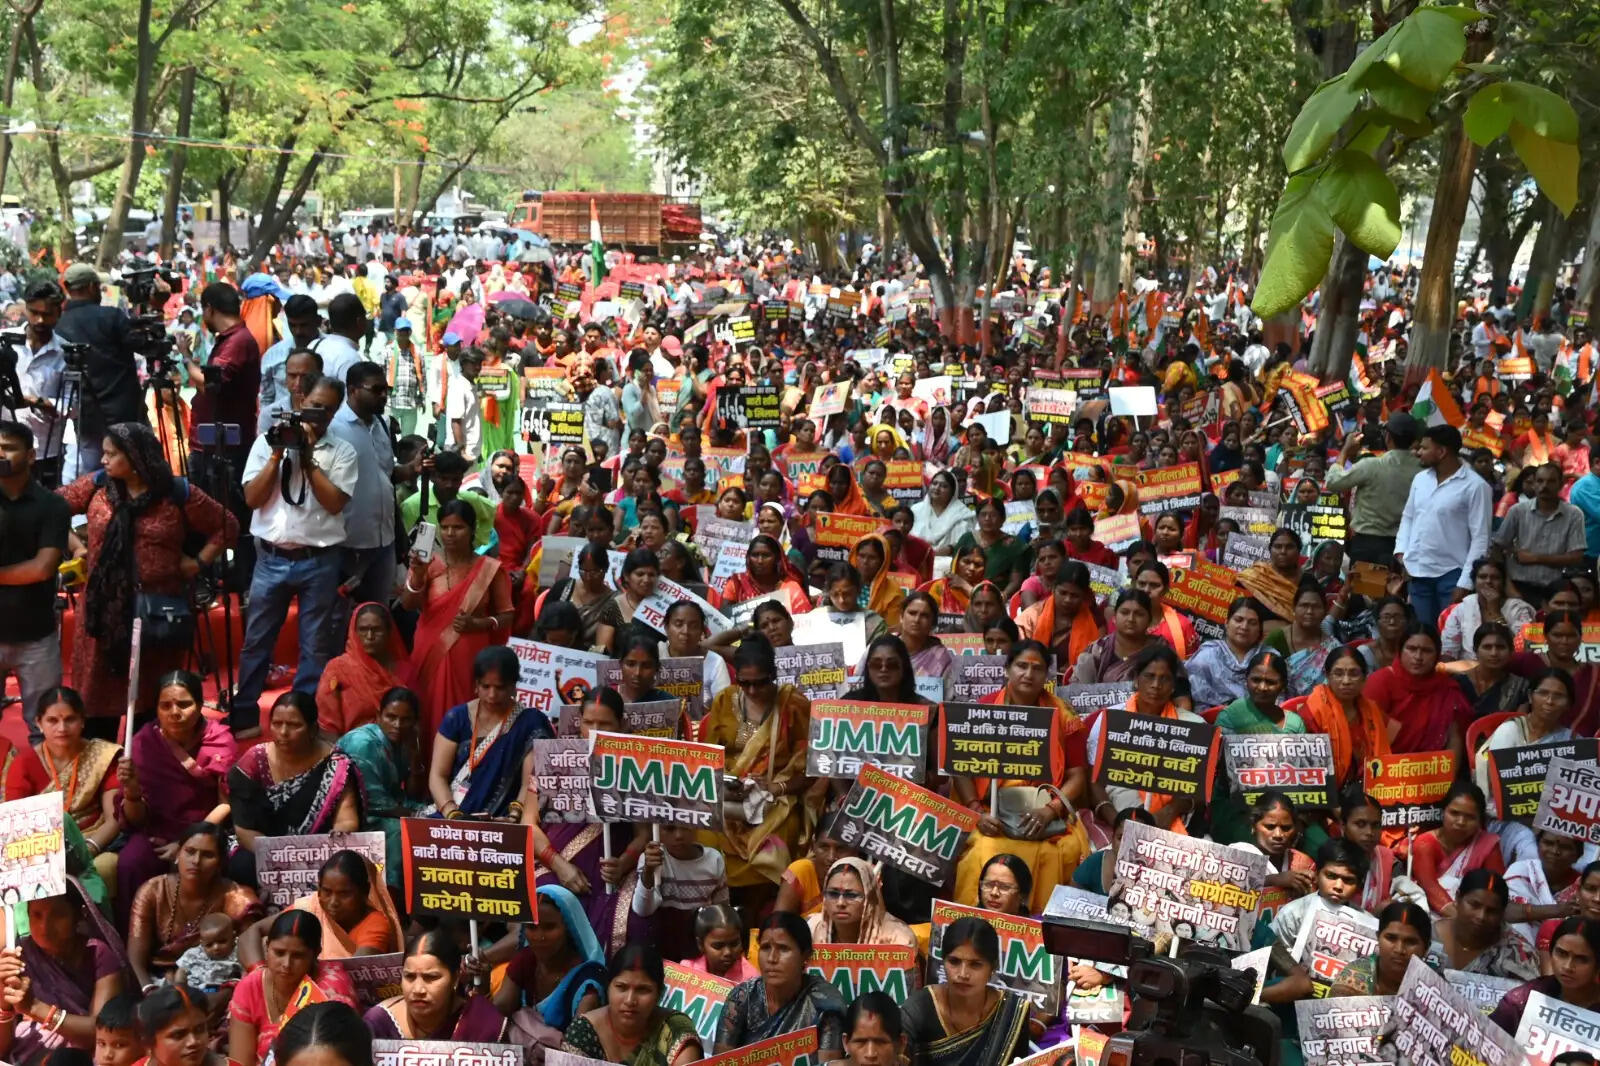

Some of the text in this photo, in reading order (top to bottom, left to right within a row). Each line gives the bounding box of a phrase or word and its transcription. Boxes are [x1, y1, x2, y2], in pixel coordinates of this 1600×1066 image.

[968, 708, 1028, 722] JMM का हाथ
[812, 717, 922, 757] JMM
[948, 722, 1048, 738] नारी शक्ति के खिलाफ
[1130, 718, 1190, 738] JMM का हाथ
[952, 739, 1043, 756] जनता नहीं
[1108, 731, 1208, 756] नारी शक्ति के खिलाफ
[1229, 737, 1327, 758] महिला विरोधी
[1517, 745, 1576, 763] JMM का हाथ
[816, 754, 834, 774] है
[952, 757, 1044, 776] करेगी माफ
[1110, 747, 1202, 774] जनता नहीं
[1387, 755, 1452, 778] महिलाओं के
[1500, 763, 1548, 779] नारी शक्ति
[538, 774, 558, 790] पर
[594, 753, 718, 804] JMM
[1107, 768, 1198, 794] करेगी माफ
[1234, 762, 1328, 787] कांग्रेस
[865, 770, 973, 825] महिलाओं के अधिकारों पर वार
[1405, 784, 1418, 798] का
[552, 794, 586, 811] की है
[601, 793, 713, 827] है जिम्मेदार
[845, 786, 962, 861] JMM
[1398, 807, 1406, 825] है
[1544, 816, 1587, 837] JMM
[429, 825, 504, 844] कांग्रेस का हाथ
[271, 844, 331, 864] महिलाओं
[412, 844, 524, 866] नारी शक्ति के खिलाफ
[840, 821, 940, 879] है जिम्मेदार
[1137, 838, 1250, 882] महिलाओं के हक
[260, 869, 278, 884] पर
[418, 866, 520, 890] जनता नहीं
[1118, 858, 1262, 912] पर सवाल, कांग्रेसियों
[273, 888, 290, 905] की
[420, 890, 522, 916] करेगी माफ
[1125, 886, 1240, 934] की है पुरानी चाल
[1316, 920, 1379, 956] महिला
[834, 948, 876, 962] अधिकारों
[878, 950, 892, 962] पर
[892, 950, 910, 962] वार
[1314, 1005, 1381, 1030] महिलाओं
[1396, 996, 1415, 1022] पर
[1416, 978, 1470, 1036] महिलाओं
[1467, 1022, 1482, 1047] के
[1481, 1032, 1507, 1064] हक
[1304, 1036, 1377, 1056] पर सवाल,
[1396, 1030, 1416, 1055] की
